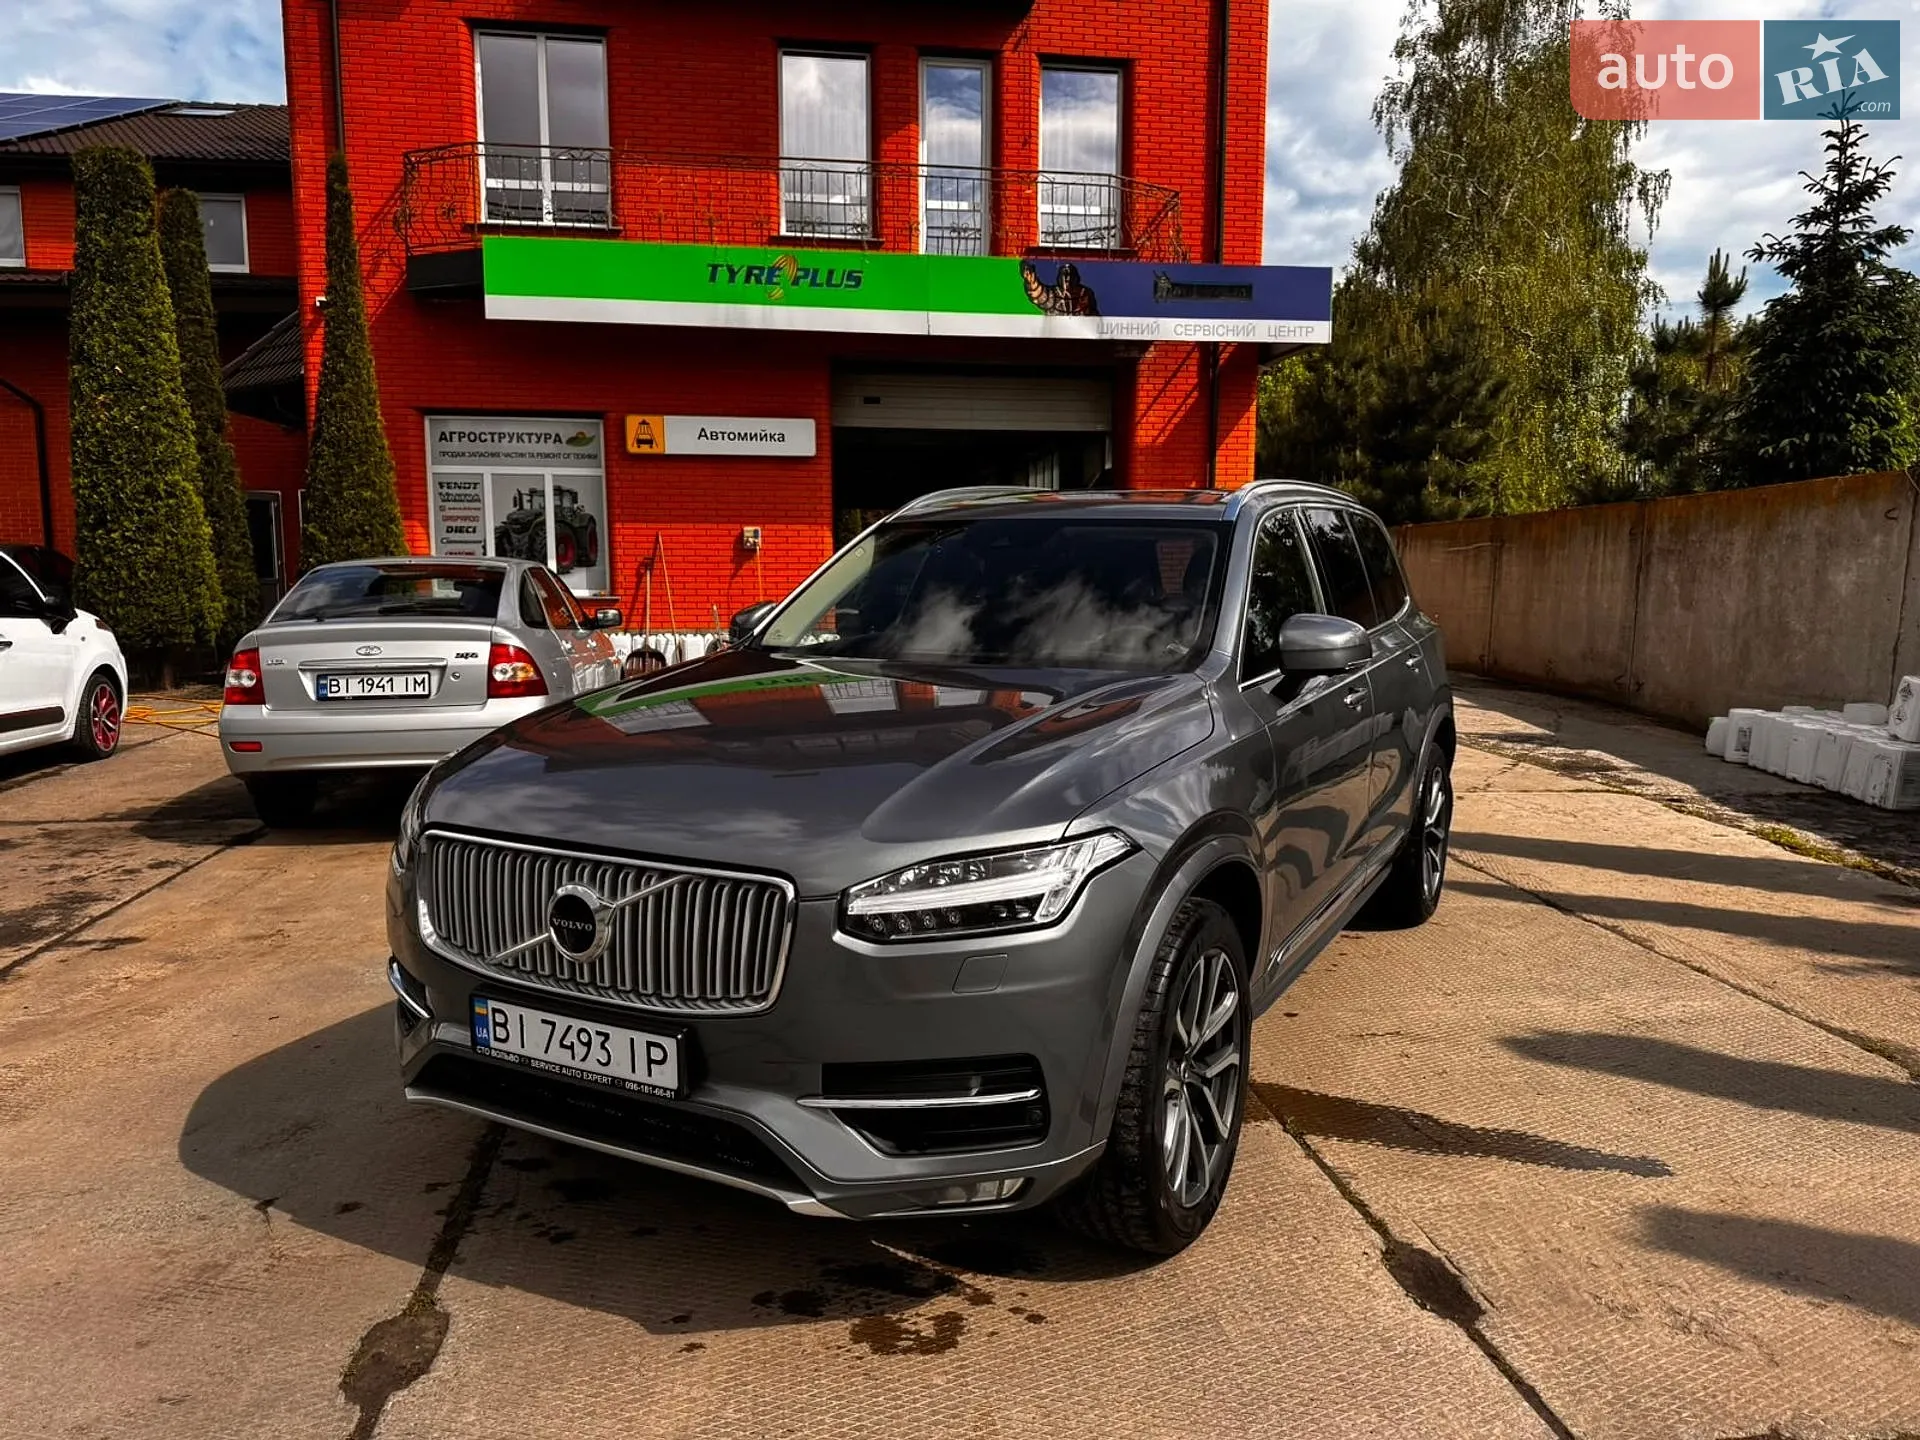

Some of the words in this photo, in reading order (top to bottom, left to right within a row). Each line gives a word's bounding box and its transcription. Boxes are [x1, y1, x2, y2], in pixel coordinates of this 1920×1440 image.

[707, 263, 784, 286] TYRE
[791, 267, 864, 290] PLUS
[1097, 320, 1161, 336] ШИННИЙ
[1173, 322, 1256, 337] СЕРВІСНИЙ
[1267, 325, 1315, 339] ЦЕНТР
[438, 431, 563, 445] АГРОСТРУКТУРА
[697, 427, 786, 443] Автомийка
[438, 481, 481, 490] FENDT
[446, 525, 477, 533] DIECI
[328, 678, 349, 694] BI
[357, 677, 394, 693] 1941
[405, 677, 426, 693] IM
[553, 918, 593, 932] VOLVO
[491, 1007, 525, 1049] BI
[540, 1018, 612, 1067] 7493
[629, 1037, 669, 1078] IP
[531, 1060, 561, 1073] SERVICE
[561, 1066, 582, 1079] AUTO
[583, 1071, 613, 1085] EXPERT
